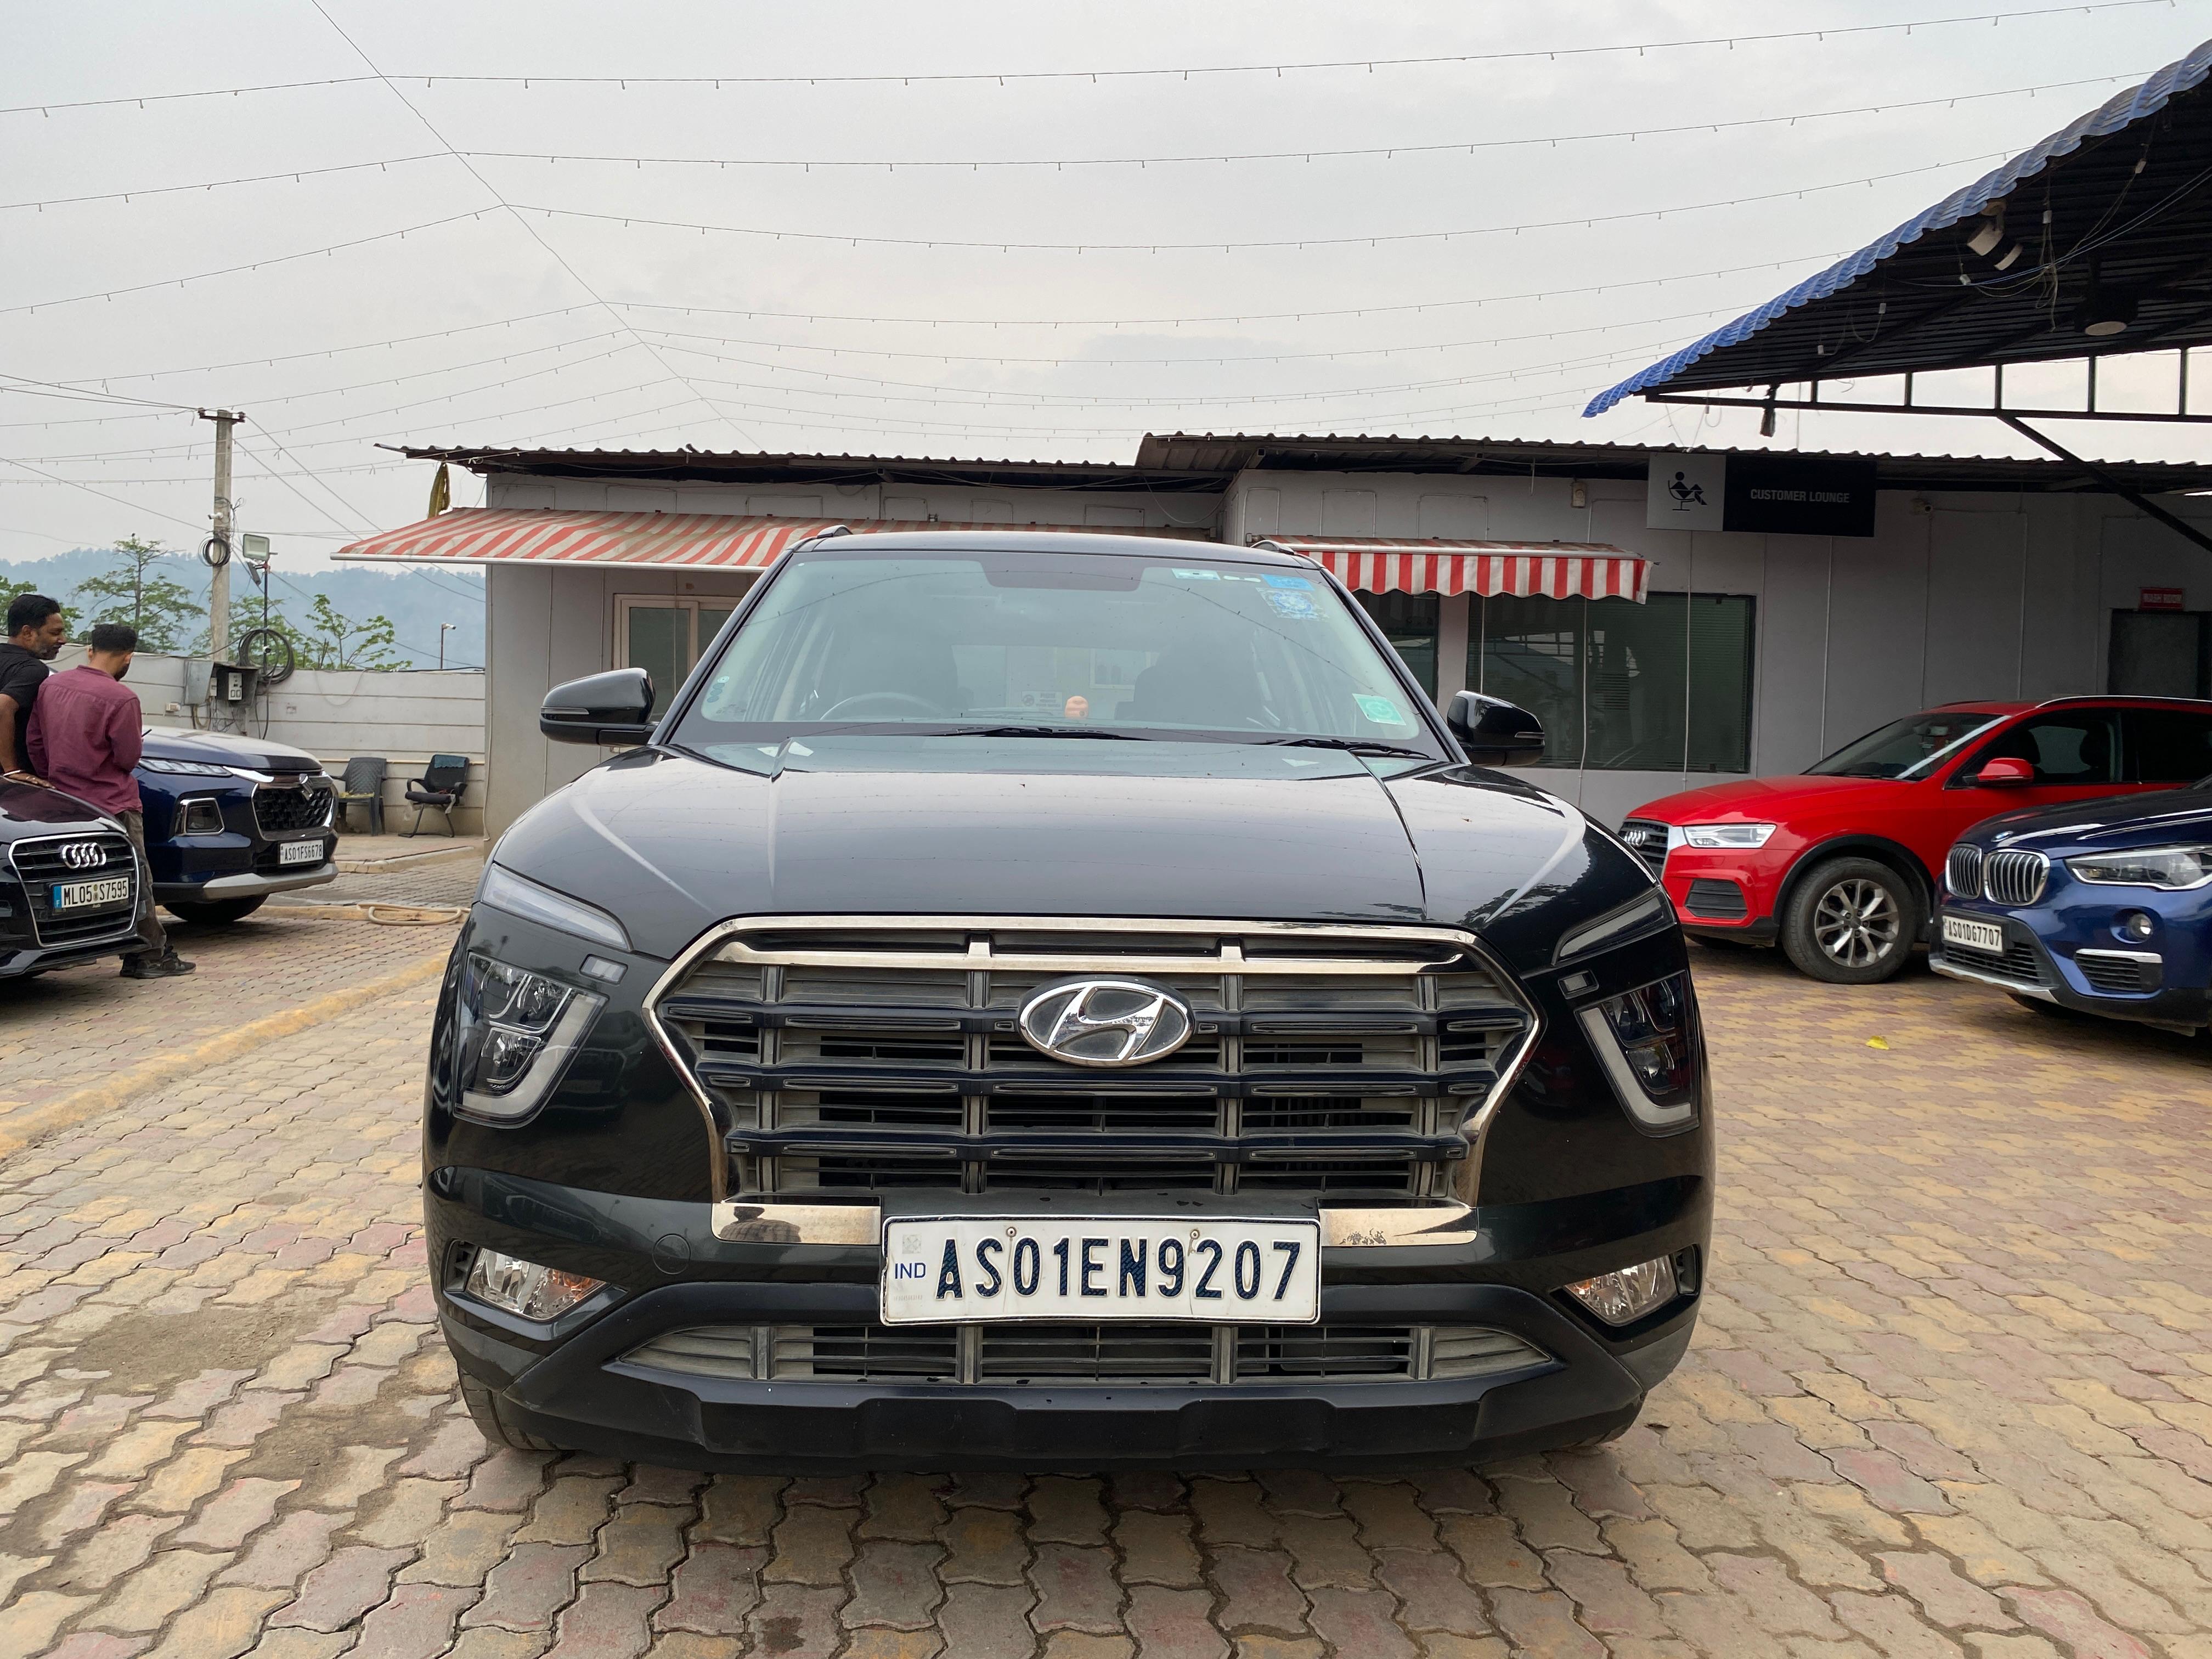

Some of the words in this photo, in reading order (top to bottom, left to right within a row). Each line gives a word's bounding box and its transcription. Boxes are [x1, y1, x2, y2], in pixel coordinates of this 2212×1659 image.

[1750, 489, 1807, 501] CUSTOMER
[1809, 492, 1850, 503] LOUNGE
[285, 844, 323, 861] AS01FS6678
[1949, 920, 2000, 946] AS01DG7707
[894, 1262, 926, 1279] IND
[935, 1236, 1300, 1301] AS01EN9207
